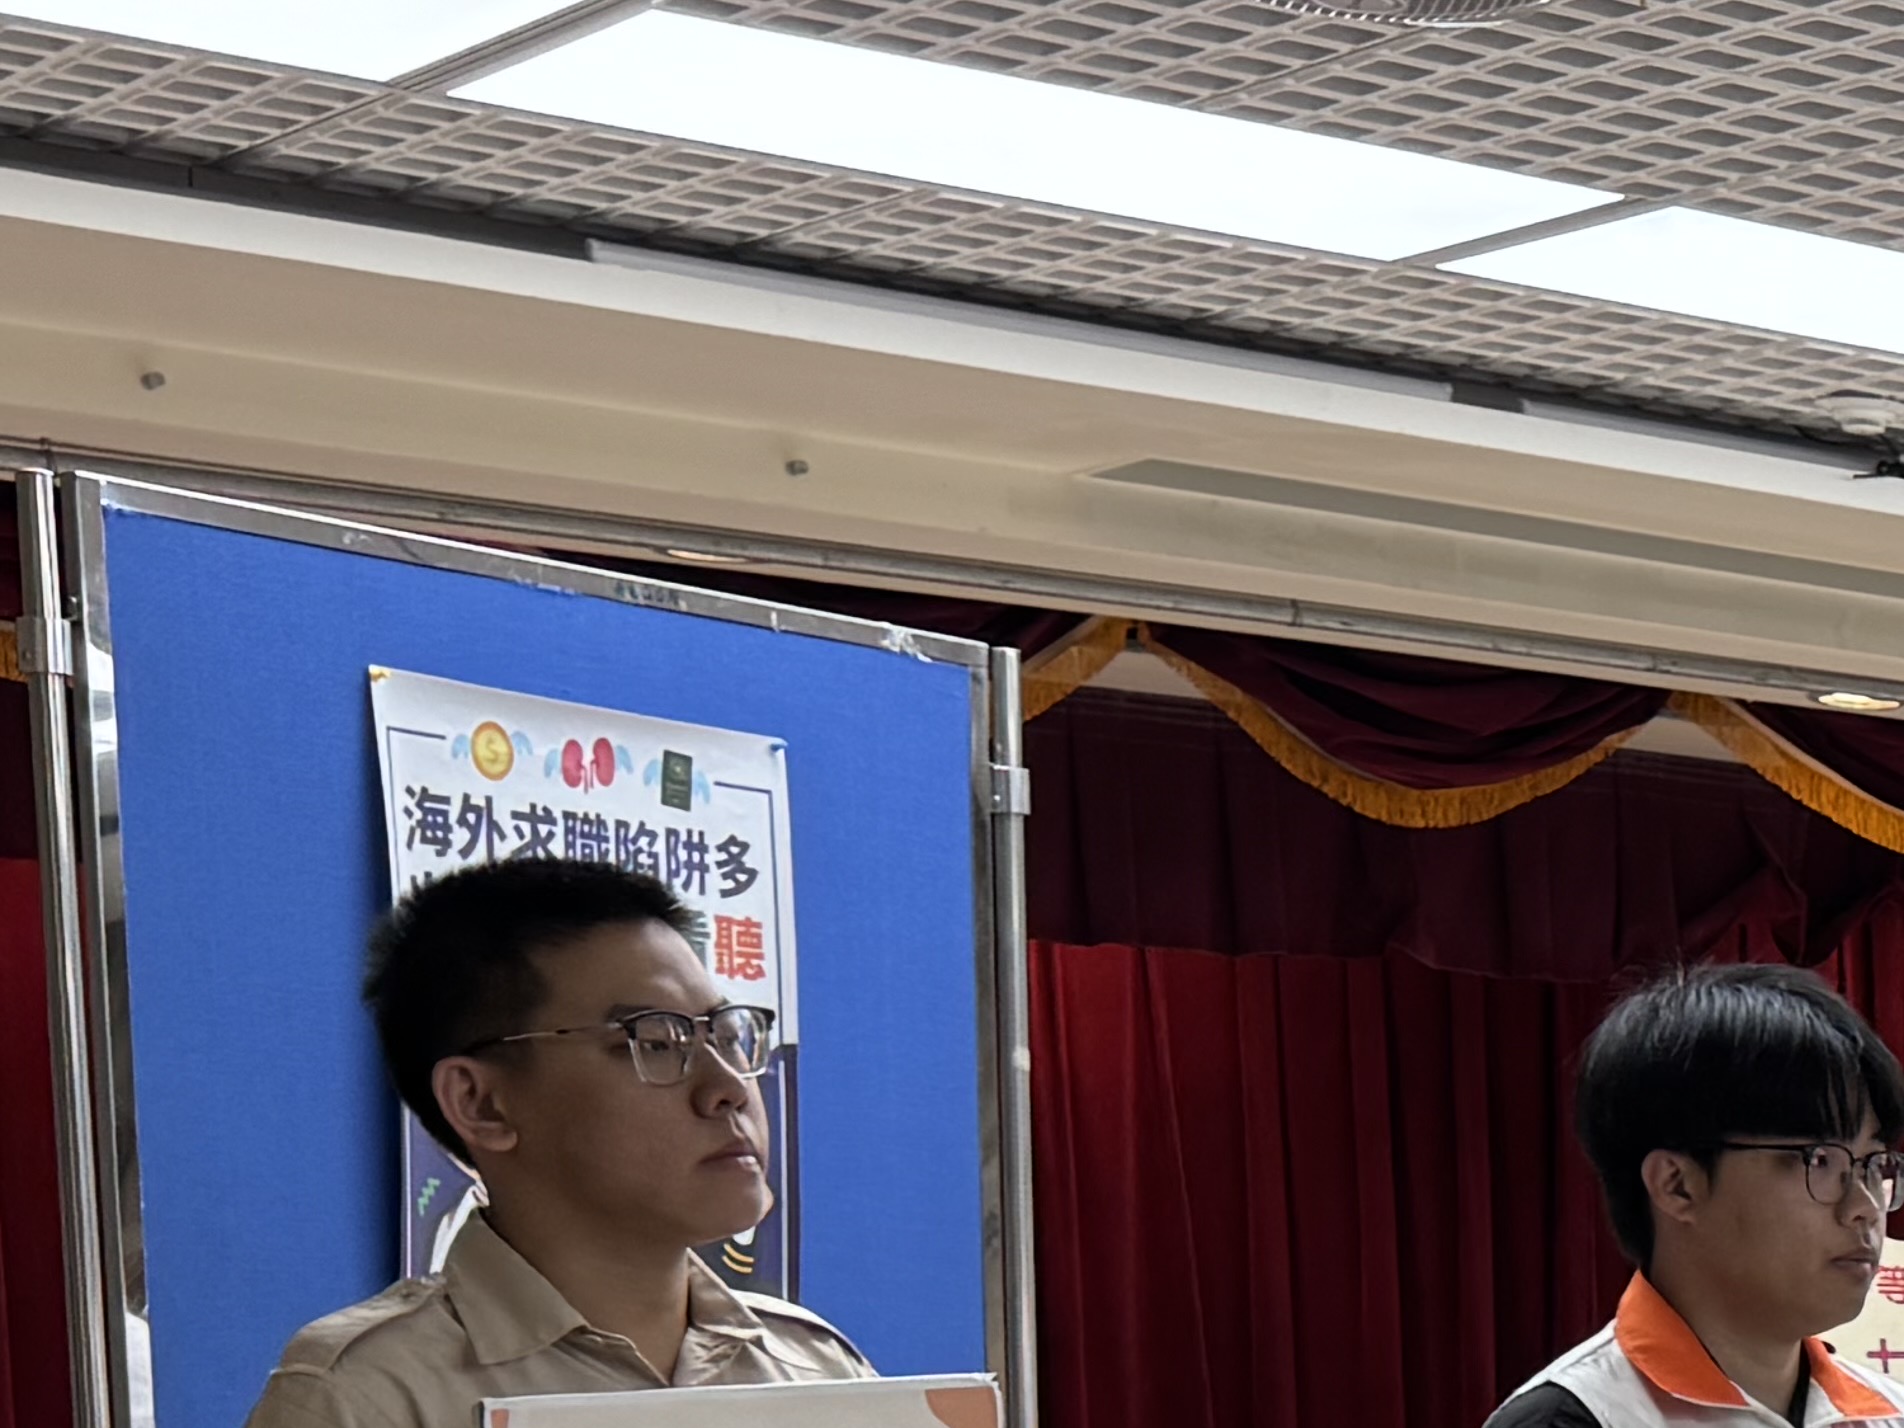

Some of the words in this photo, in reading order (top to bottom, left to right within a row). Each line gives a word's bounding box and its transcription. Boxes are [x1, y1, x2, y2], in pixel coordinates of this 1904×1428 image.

[403, 784, 759, 899] 海外求職陷阱多
